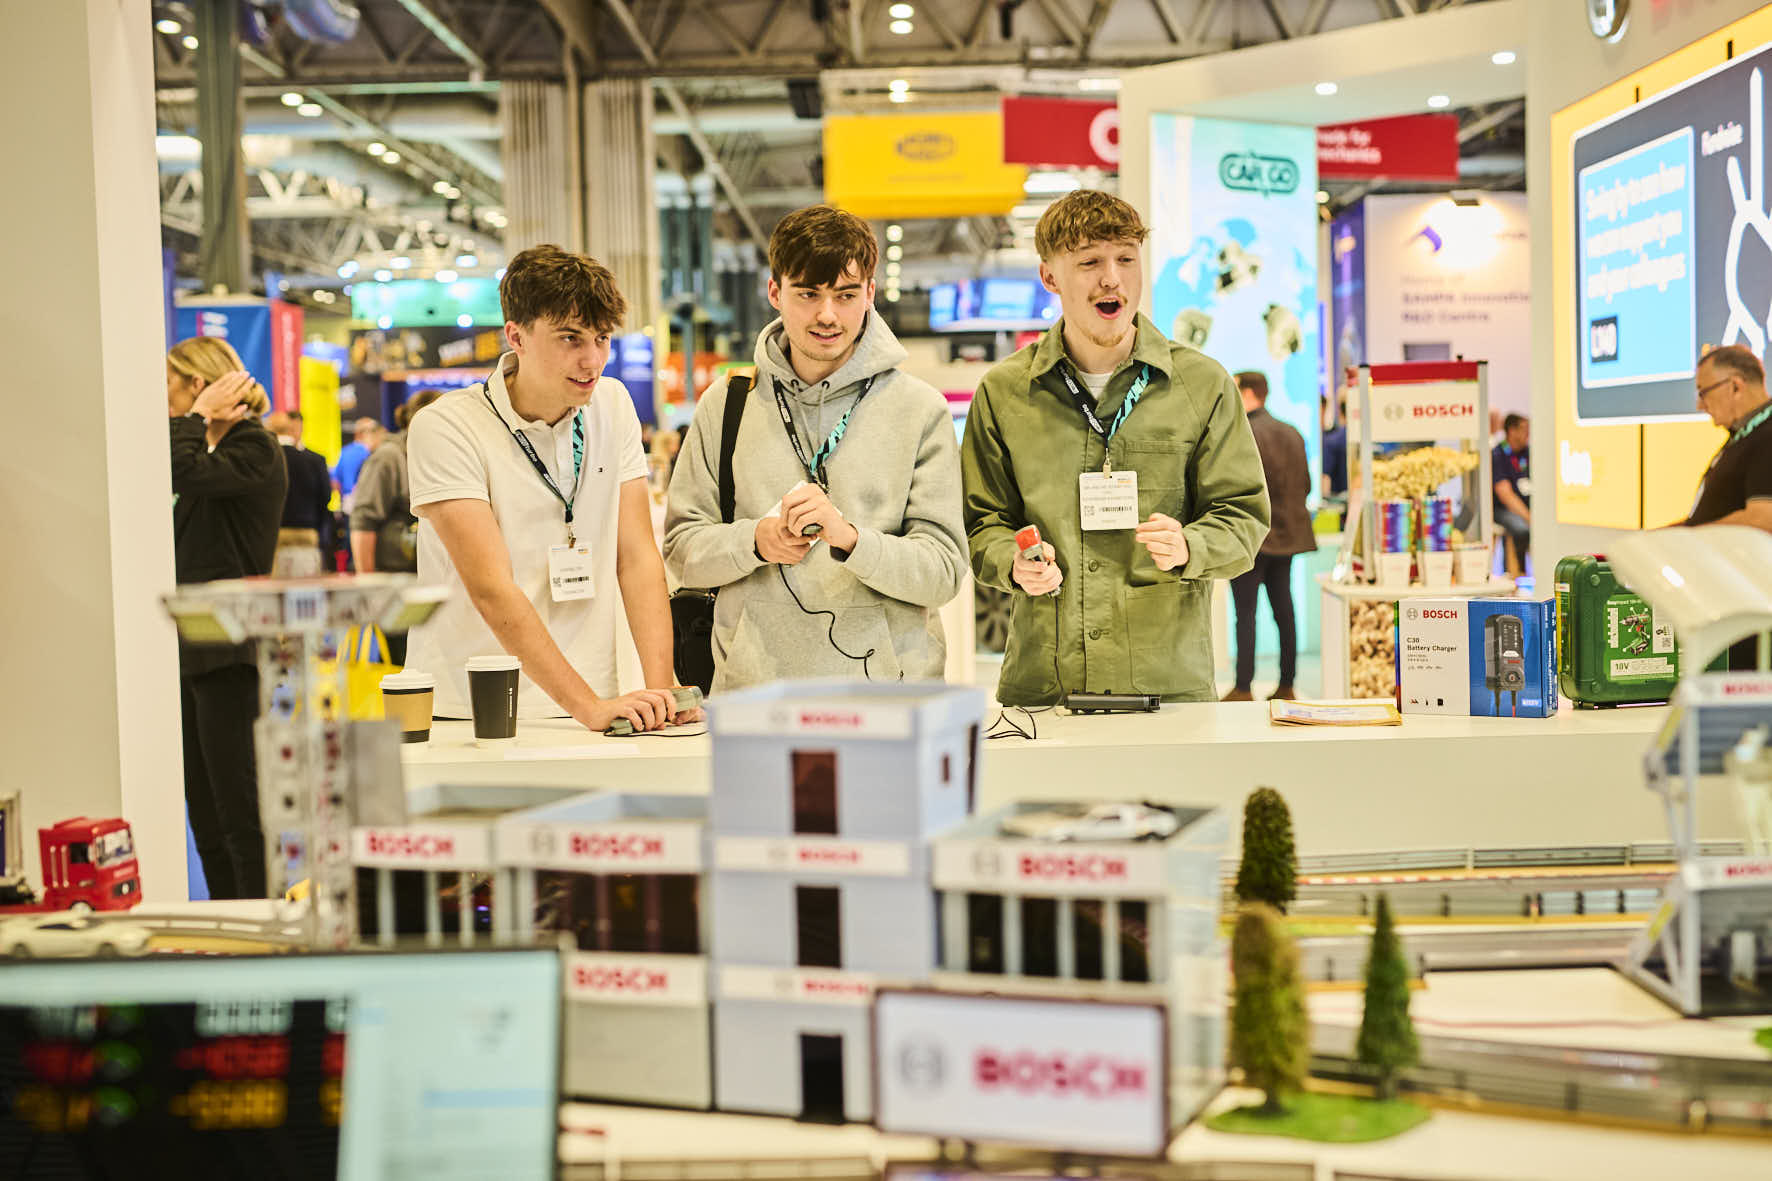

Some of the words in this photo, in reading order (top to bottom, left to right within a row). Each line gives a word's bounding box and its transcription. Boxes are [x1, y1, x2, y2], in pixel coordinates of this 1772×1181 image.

[1412, 404, 1474, 418] BOSCH
[1423, 610, 1458, 619] BOSCH
[799, 711, 864, 729] BOSCH
[367, 832, 454, 857] BOSCH
[570, 833, 664, 859] BOSCH
[797, 847, 862, 864] BOSCH
[1019, 854, 1127, 880] BOSCH
[574, 966, 668, 991] BOSCH
[974, 1050, 1146, 1095] BOSCH
